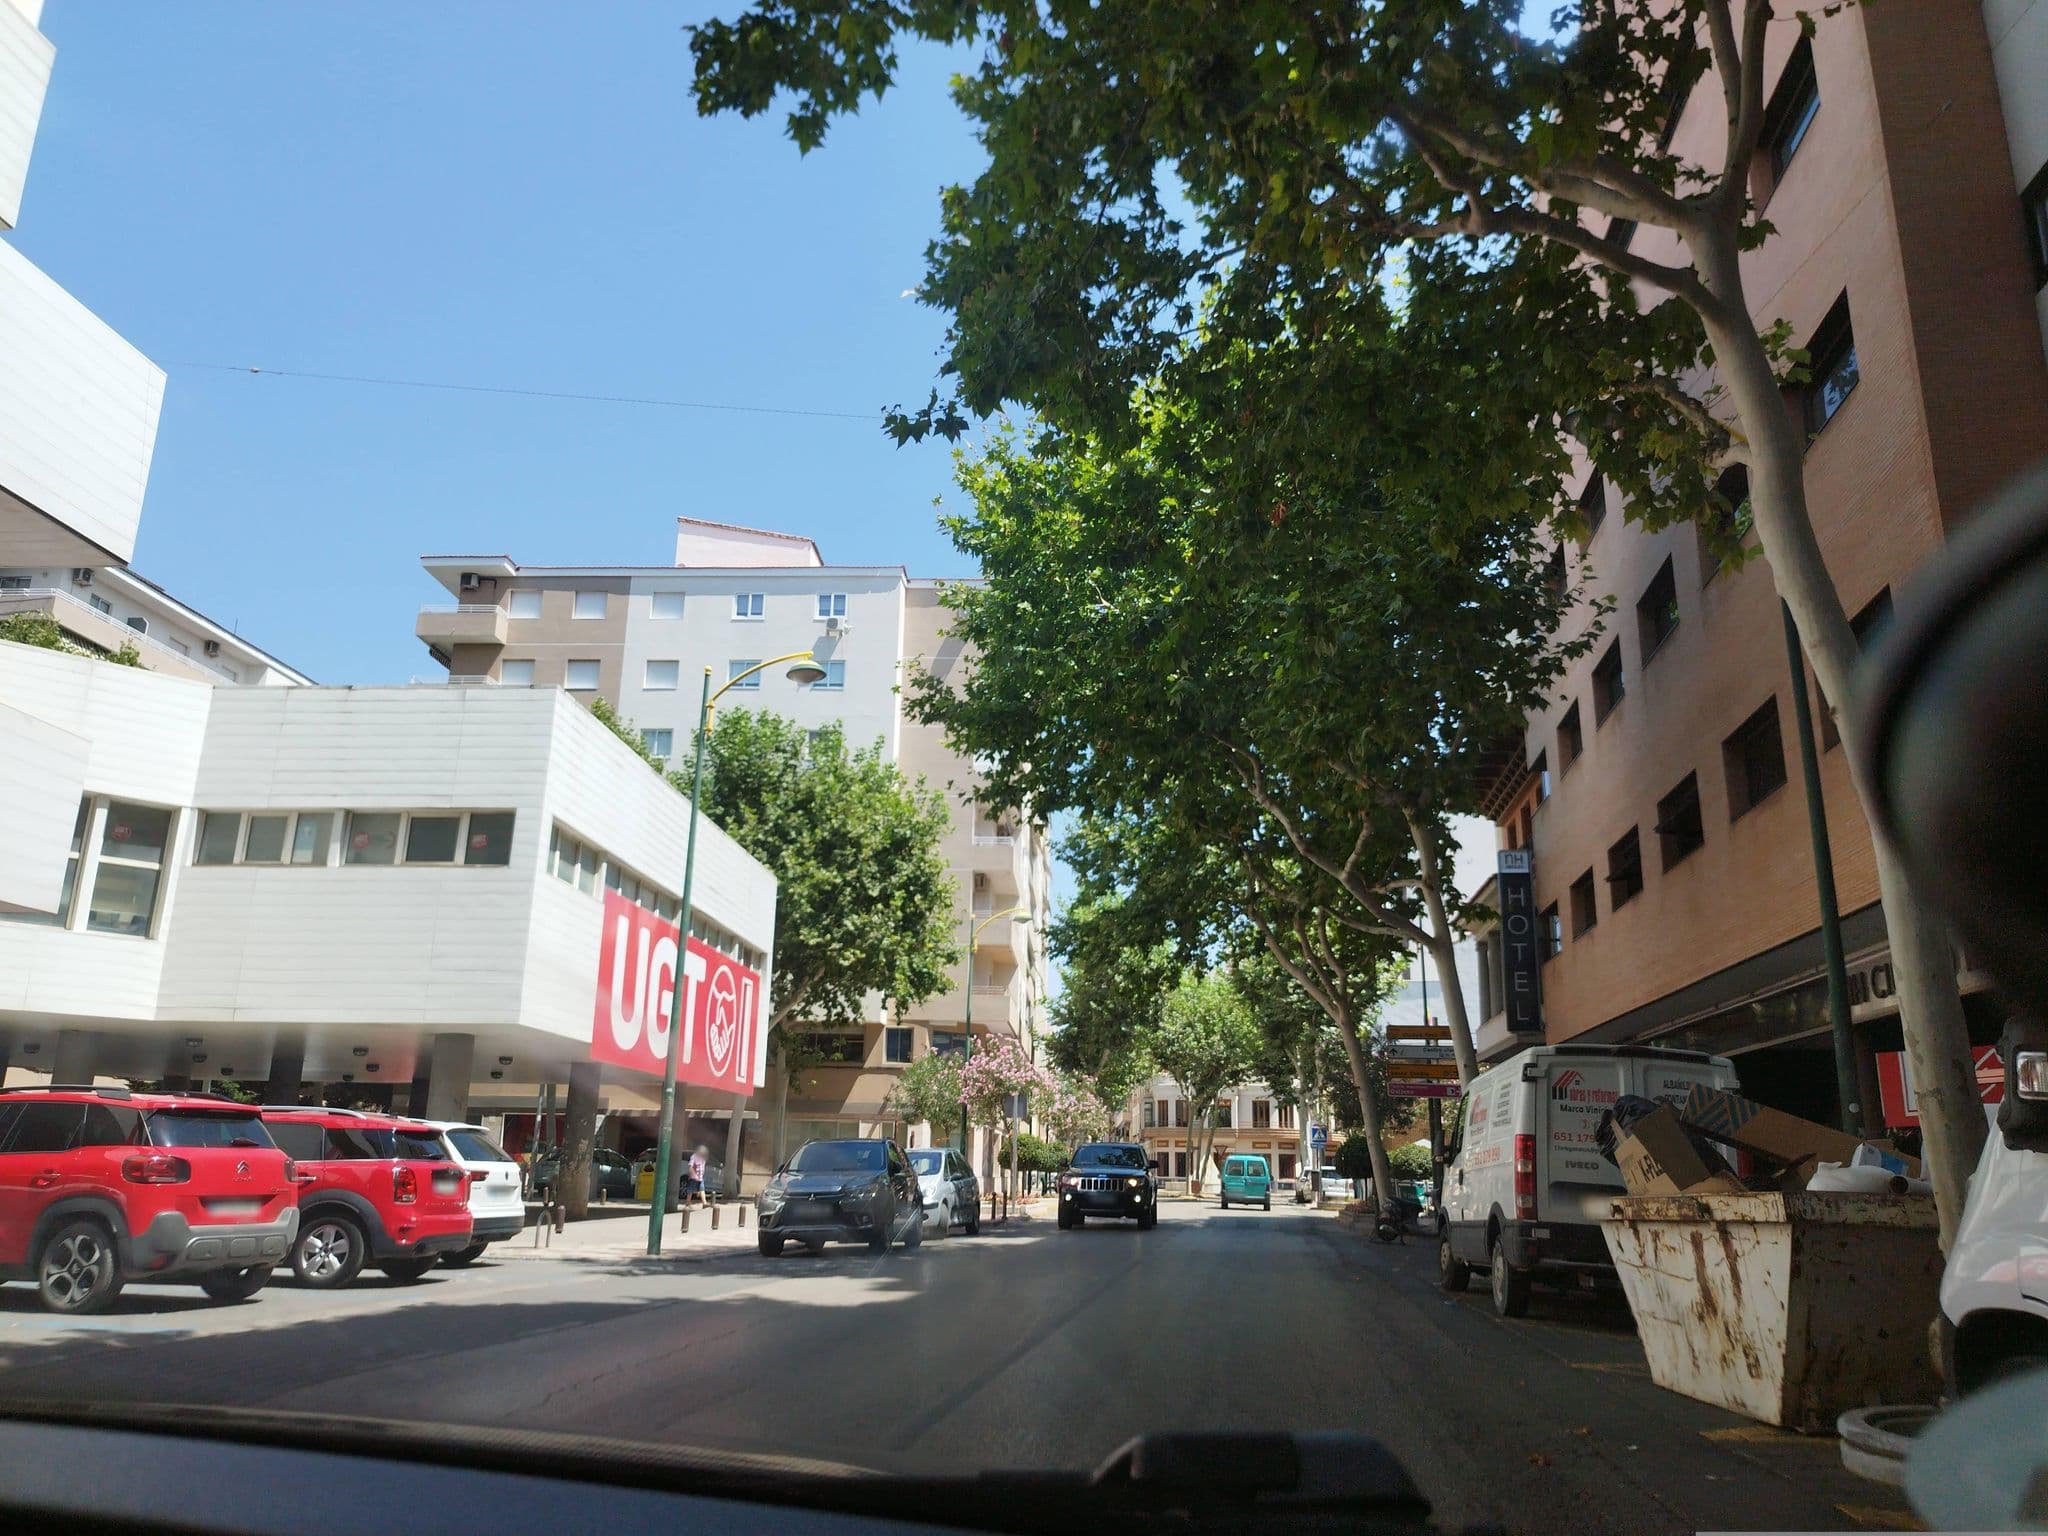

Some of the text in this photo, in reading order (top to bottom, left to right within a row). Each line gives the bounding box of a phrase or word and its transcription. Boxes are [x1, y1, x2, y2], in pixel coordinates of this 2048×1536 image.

[1507, 887, 1529, 1021] HOTEL
[610, 914, 707, 1065] UGT
[1560, 1104, 1584, 1113] Marco
[1553, 1131, 1573, 1142] 651
[1565, 1159, 1600, 1170] IVECO
